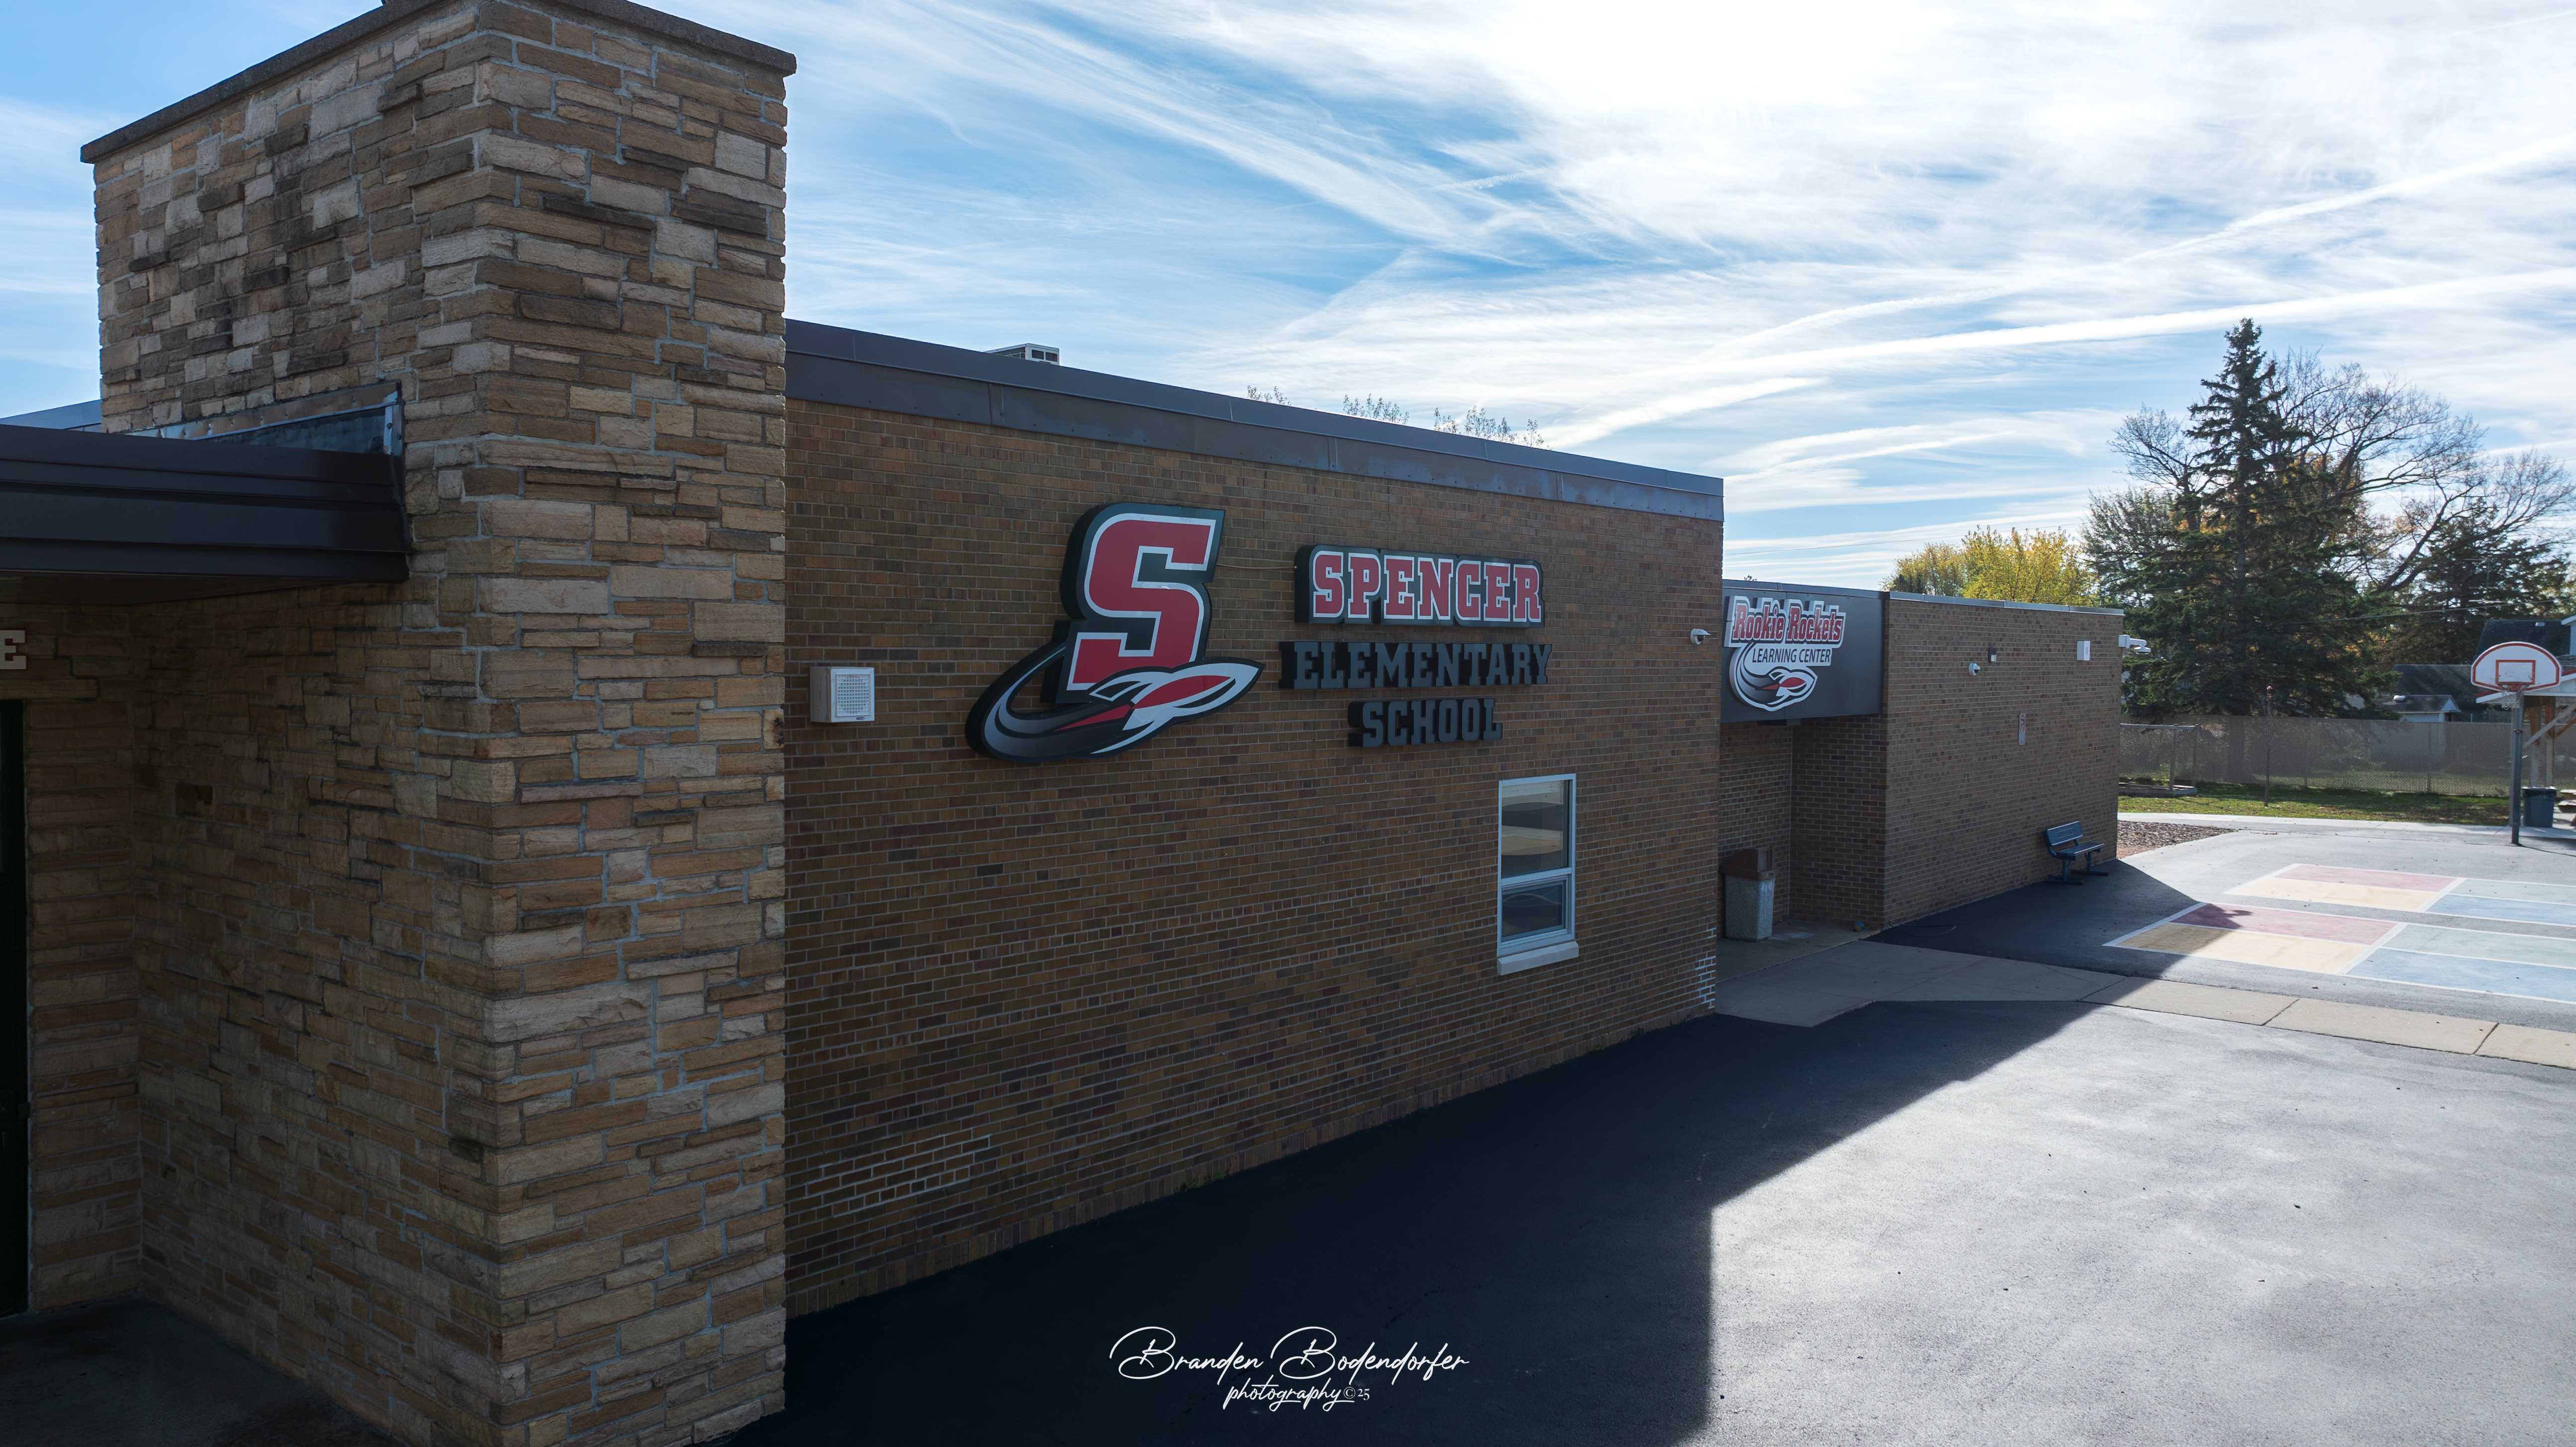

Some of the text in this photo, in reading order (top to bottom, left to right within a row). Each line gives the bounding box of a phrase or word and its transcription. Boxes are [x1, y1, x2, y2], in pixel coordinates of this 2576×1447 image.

[1312, 550, 1542, 622] SPENCER
[1732, 601, 1843, 642] Rookie Rockets
[1293, 641, 1552, 690] ELEMENTARY
[1752, 648, 1831, 663] LEARNING CENTER
[1363, 698, 1503, 747] SCHOOL
